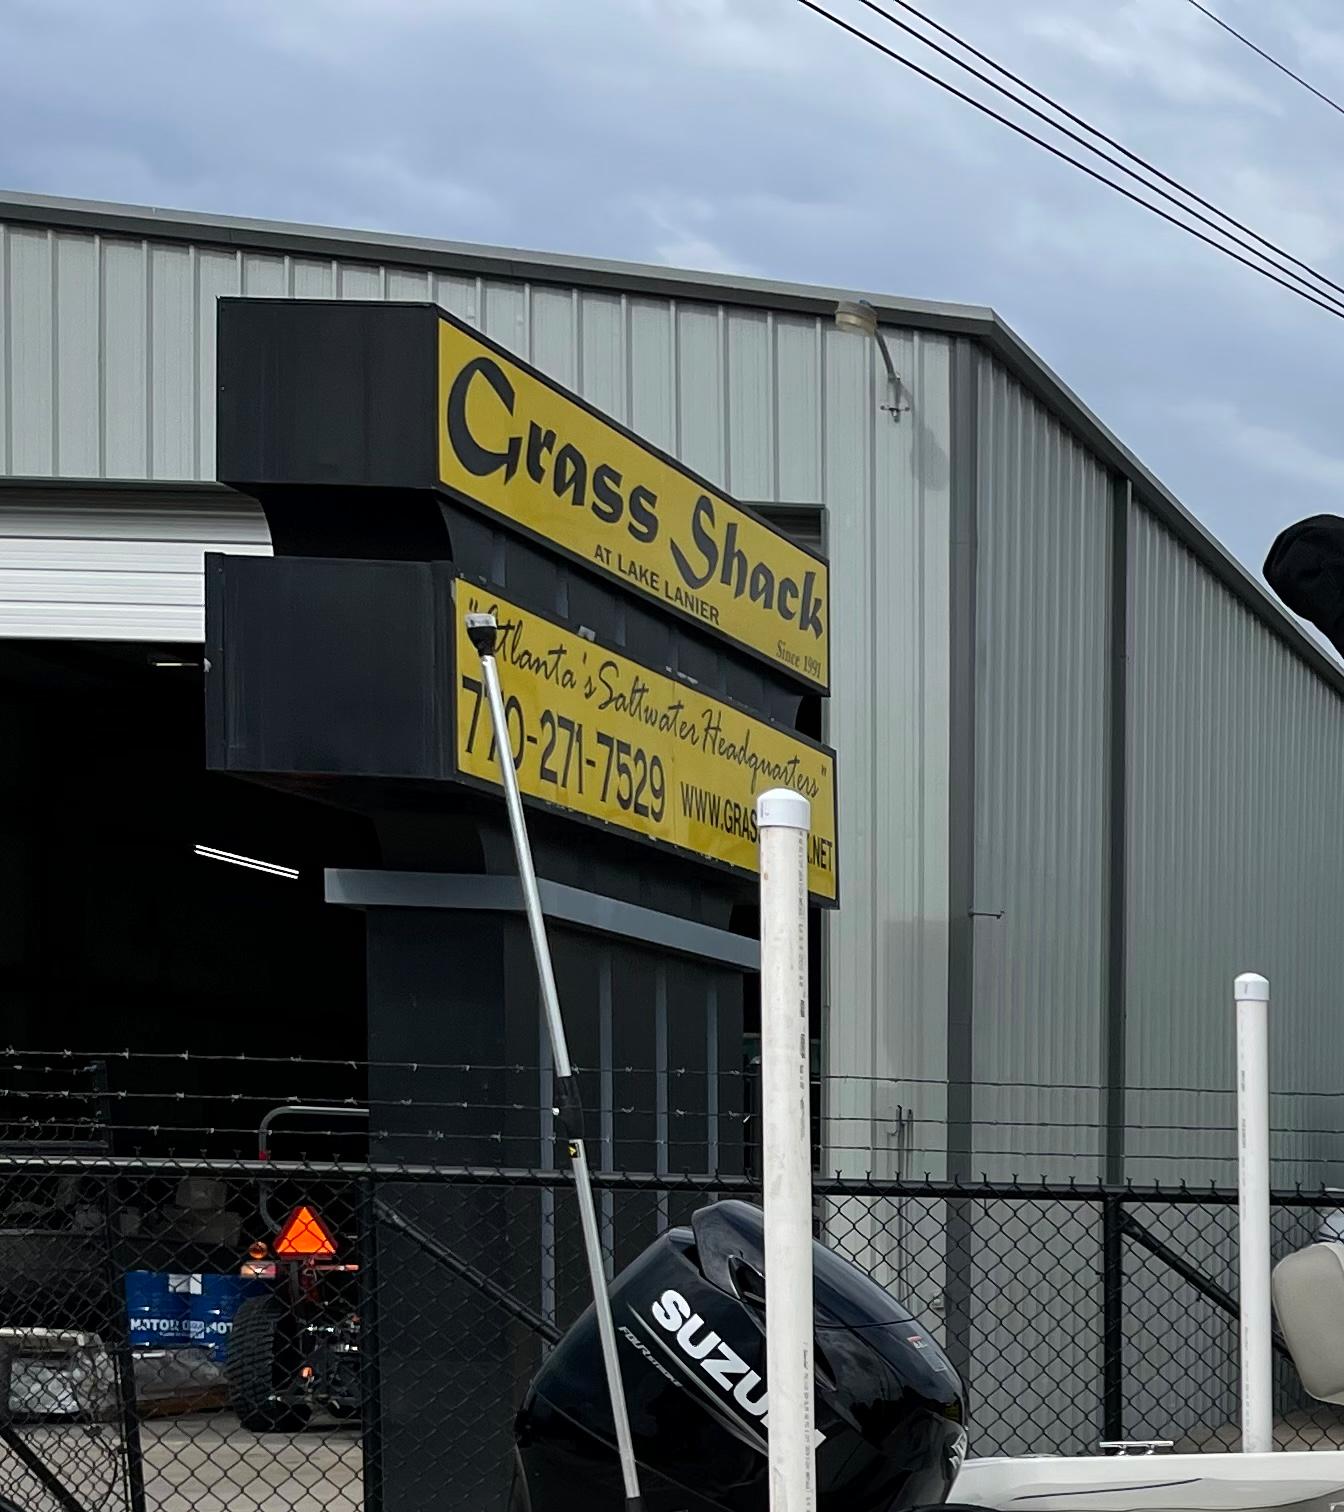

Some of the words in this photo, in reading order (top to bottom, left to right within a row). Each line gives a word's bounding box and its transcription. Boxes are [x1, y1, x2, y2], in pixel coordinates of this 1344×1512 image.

[447, 356, 660, 544] Grass
[670, 494, 824, 640] Shack
[594, 544, 612, 566] AT
[618, 553, 660, 592] LAKE
[665, 580, 720, 626] LANIER
[776, 640, 800, 669] Since
[599, 661, 699, 745] Saltwater
[652, 1289, 827, 1450] SUZU
